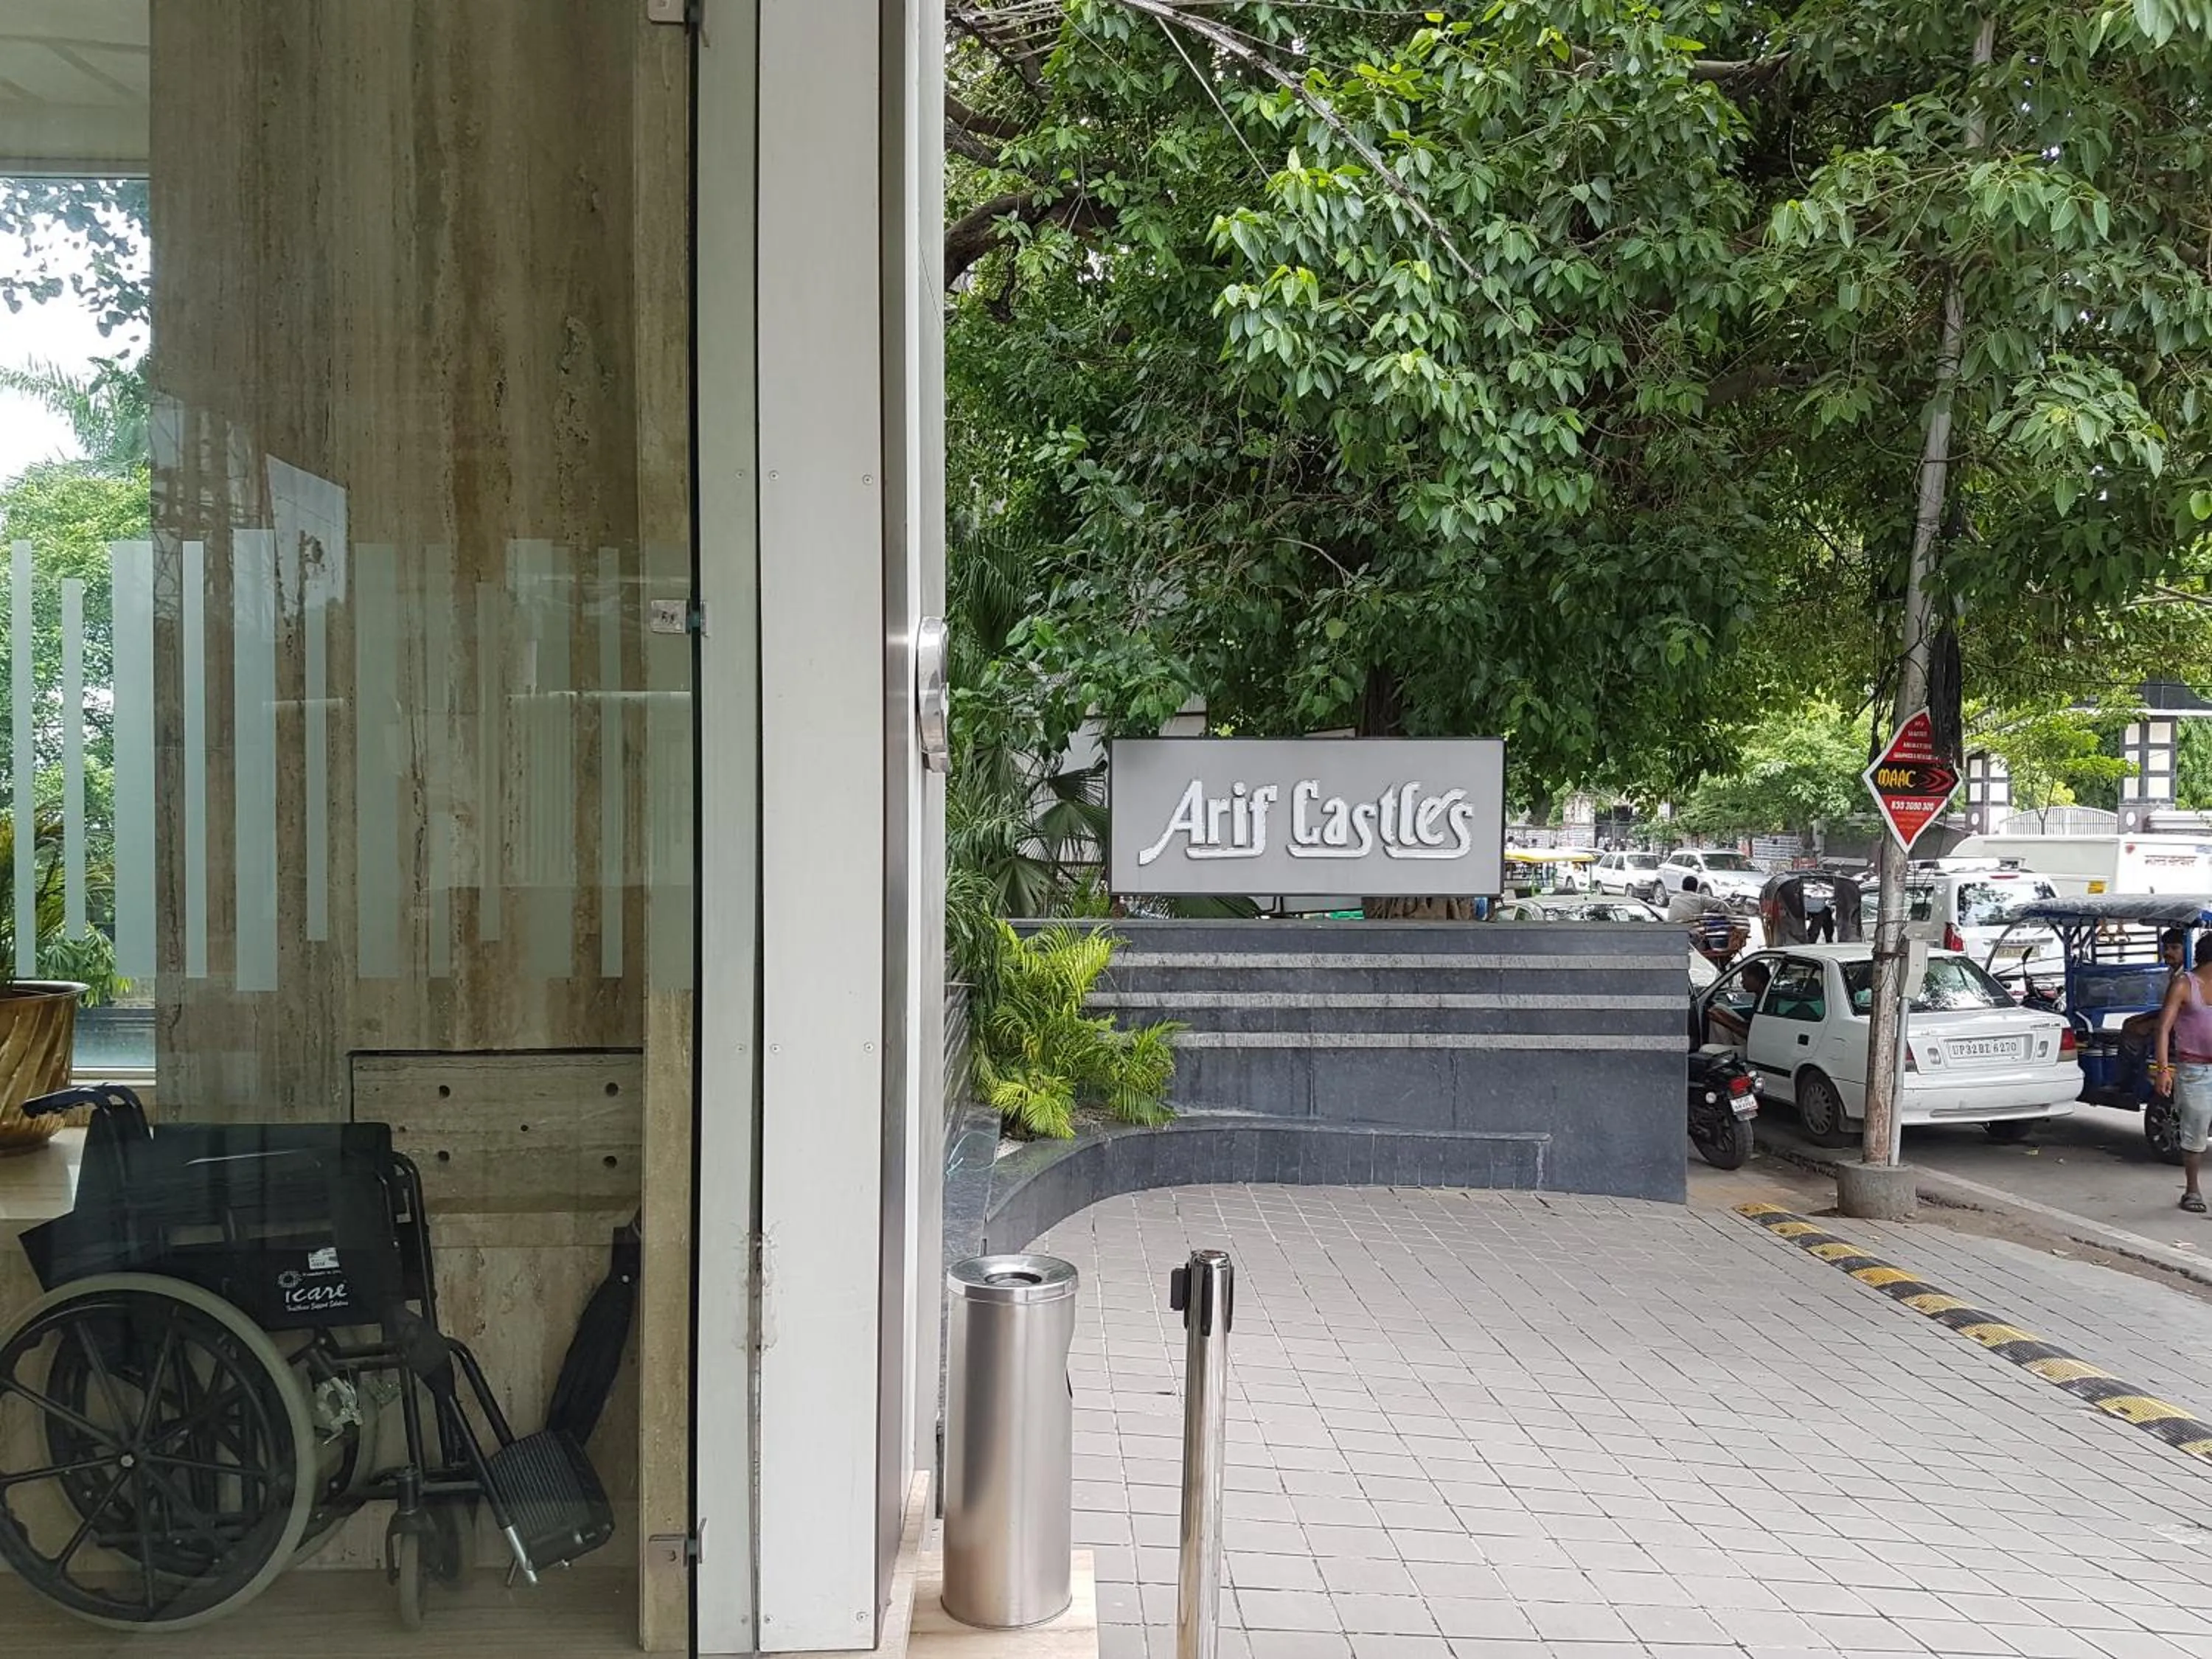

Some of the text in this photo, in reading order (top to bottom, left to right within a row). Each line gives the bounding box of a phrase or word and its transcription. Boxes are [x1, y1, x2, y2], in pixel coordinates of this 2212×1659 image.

[1877, 768, 1917, 788] MAAC
[1137, 778, 1474, 866] Arif Castles
